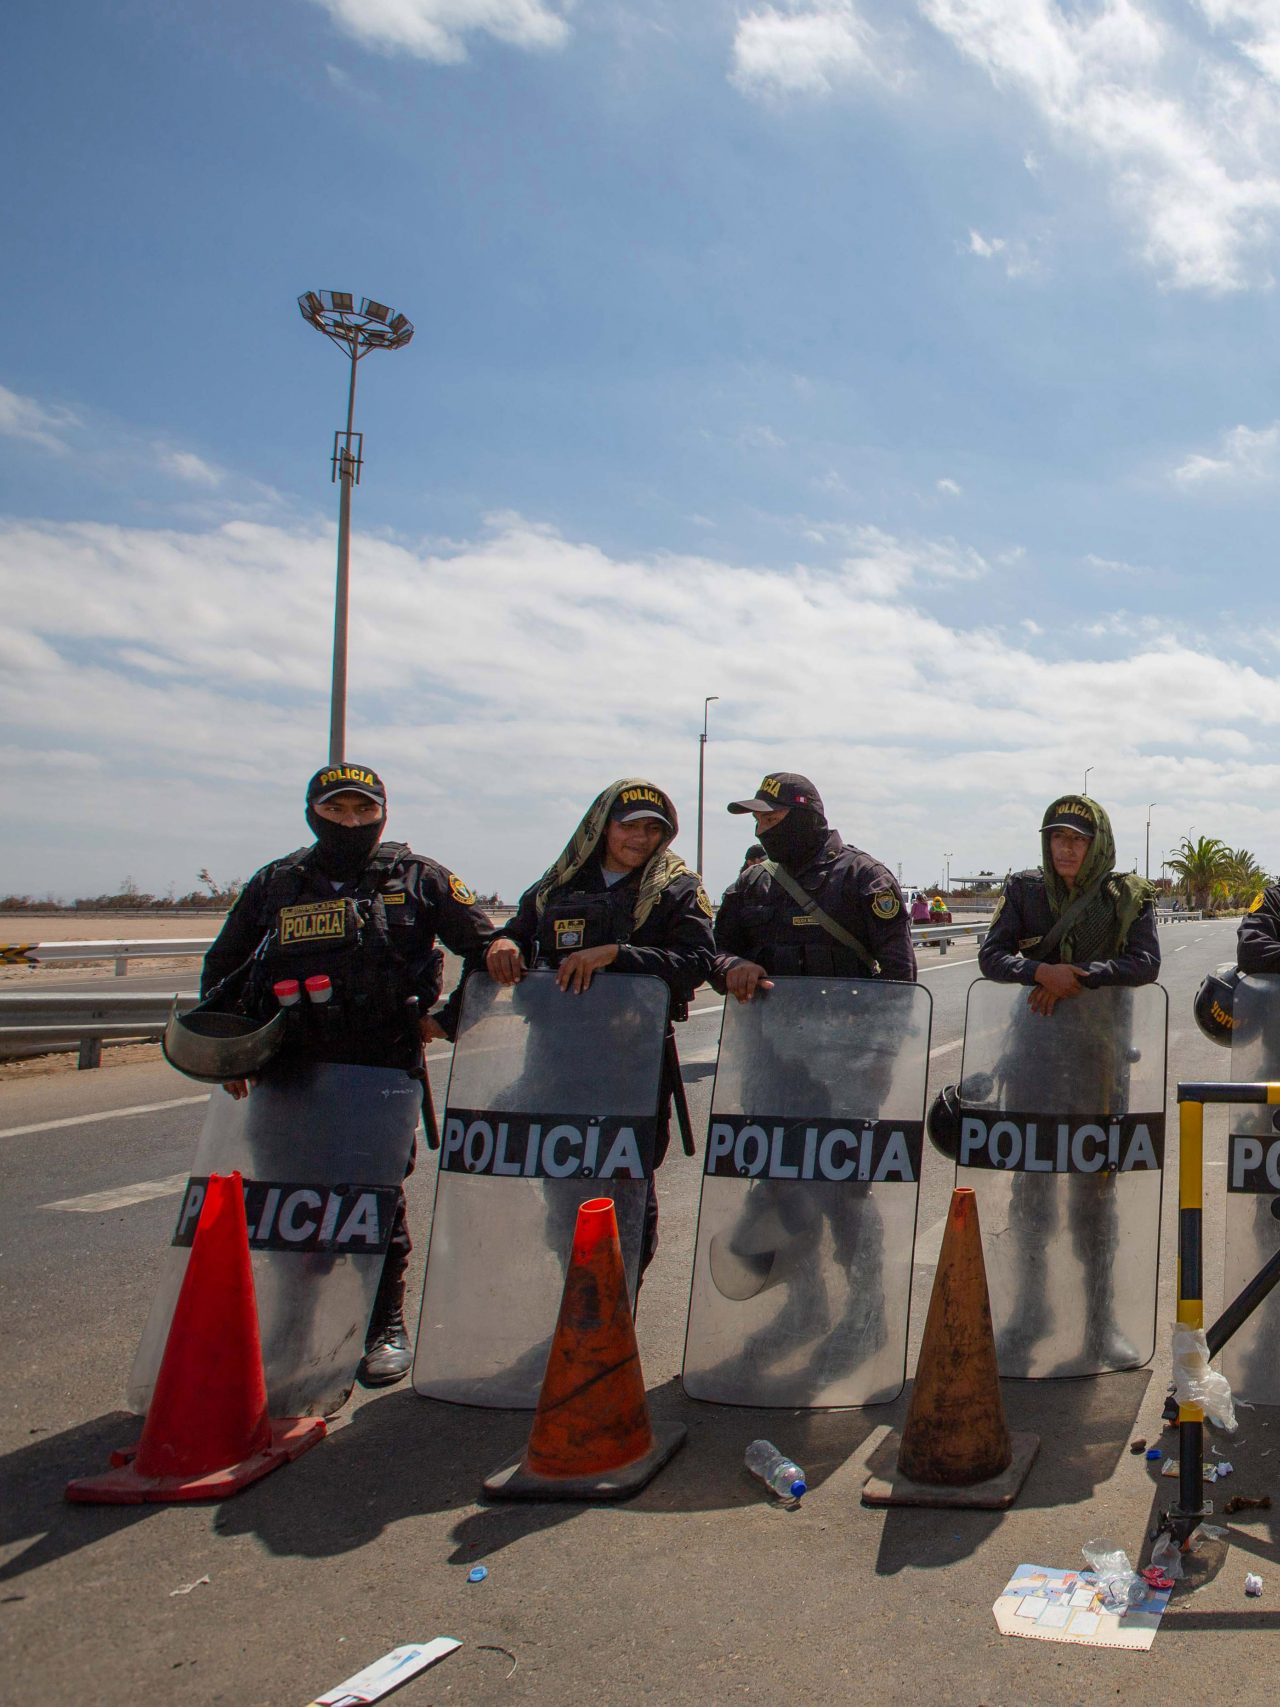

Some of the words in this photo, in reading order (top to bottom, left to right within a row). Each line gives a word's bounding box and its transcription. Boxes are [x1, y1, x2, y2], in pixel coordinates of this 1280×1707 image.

[320, 768, 374, 786] POLICIA
[284, 911, 342, 940] POLICIA
[178, 1185, 380, 1244] PICIA
